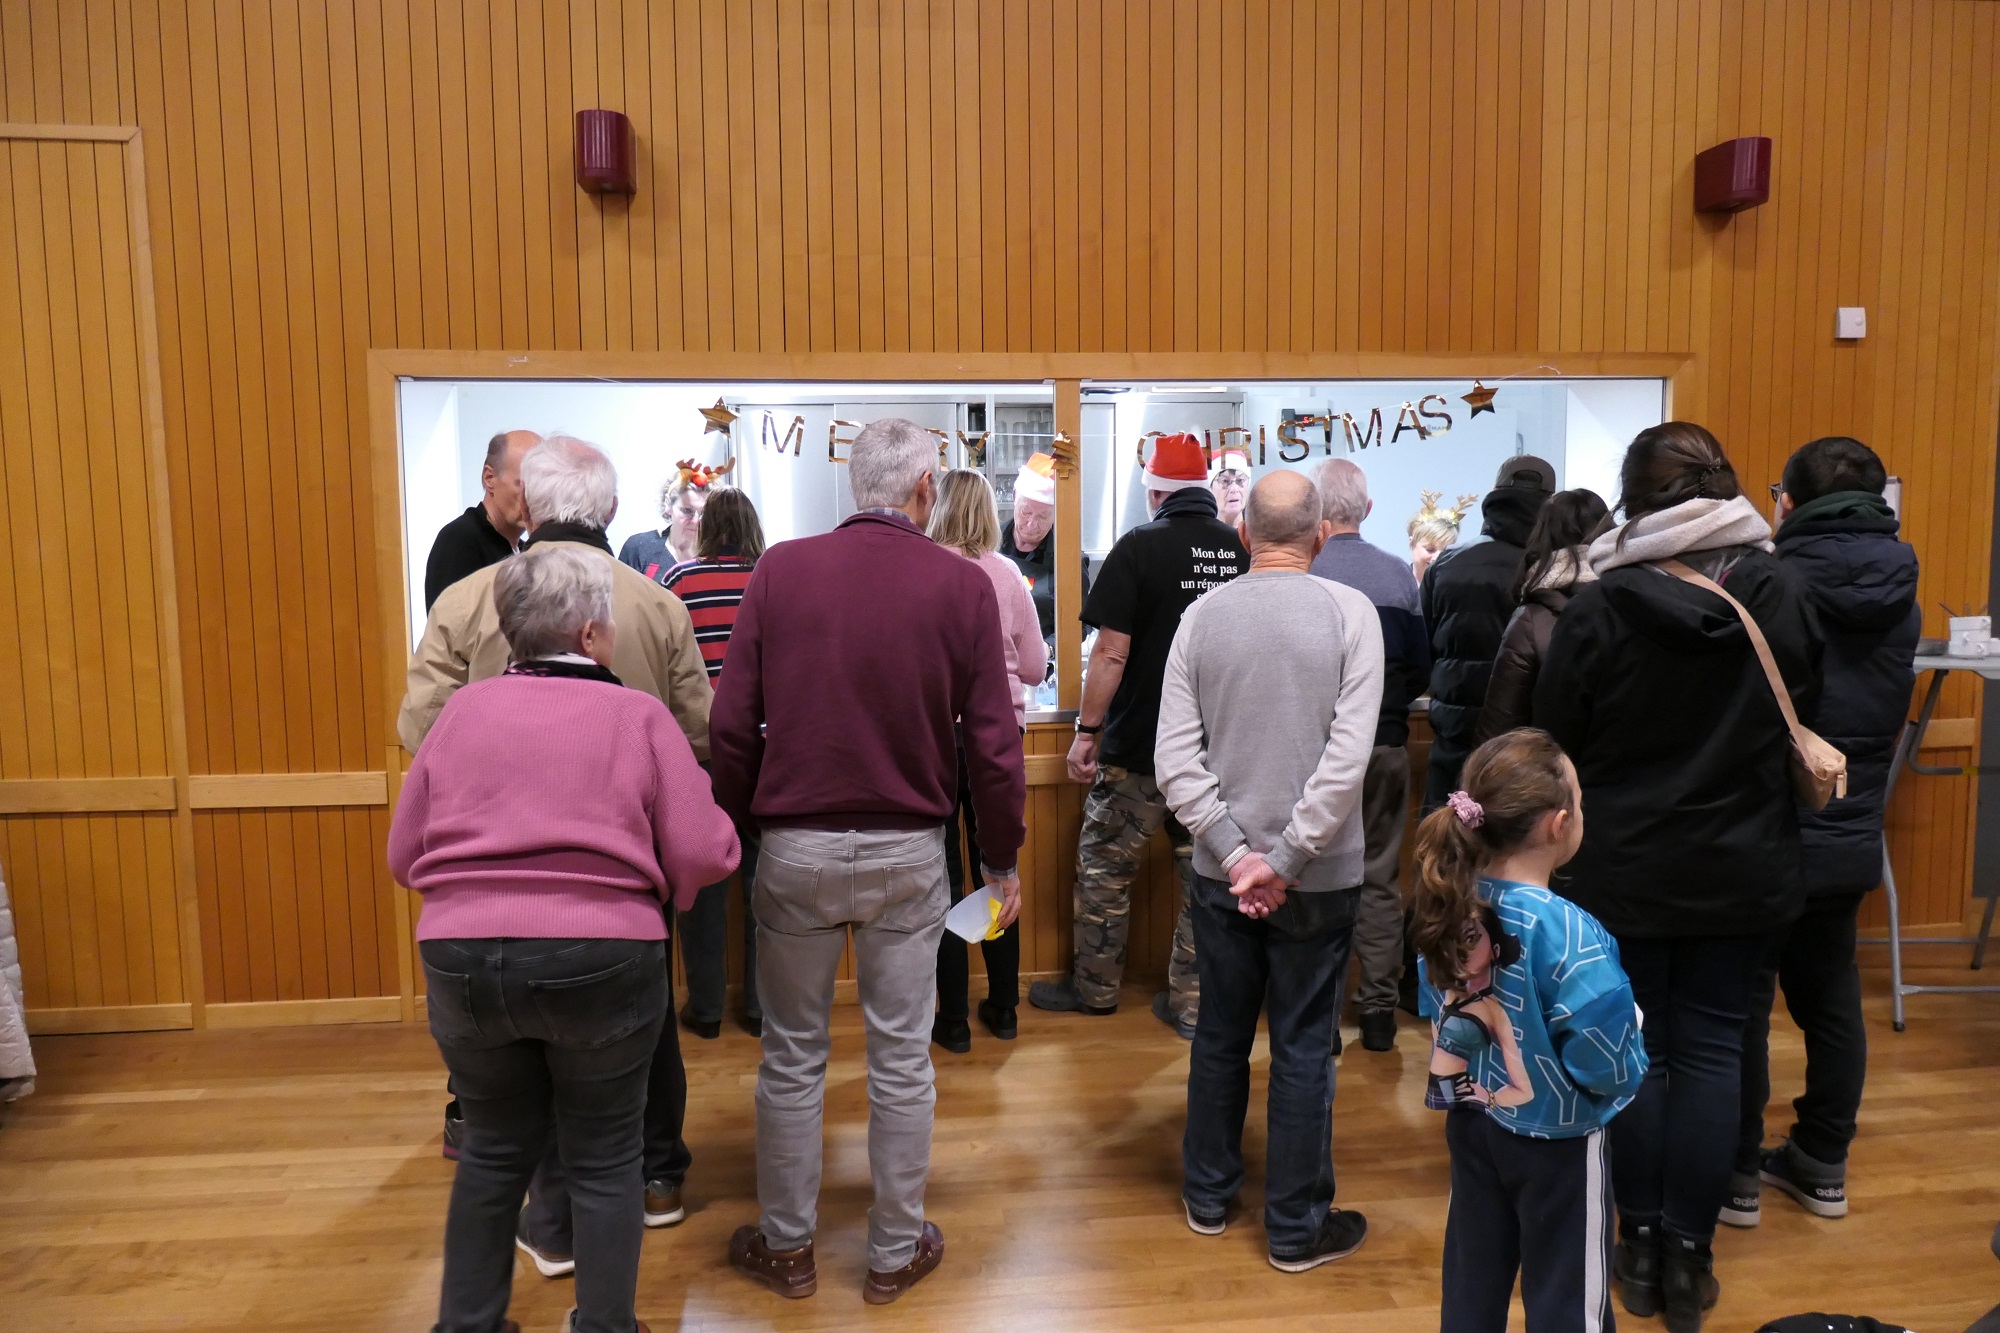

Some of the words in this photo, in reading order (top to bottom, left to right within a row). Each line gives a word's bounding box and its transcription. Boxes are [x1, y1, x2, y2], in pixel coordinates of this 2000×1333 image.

[1191, 547, 1215, 558] Mon
[1217, 548, 1236, 558] dos
[1220, 565, 1238, 577] pas
[1181, 580, 1195, 589] un
